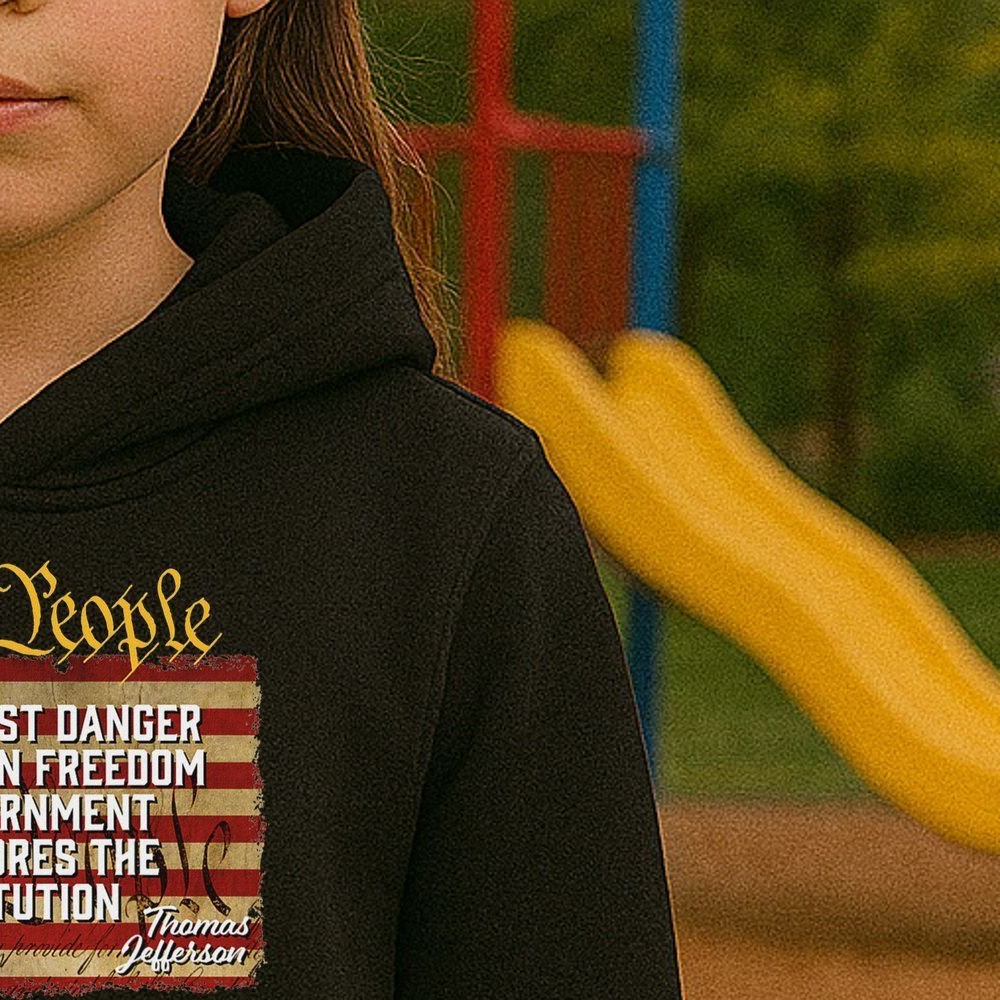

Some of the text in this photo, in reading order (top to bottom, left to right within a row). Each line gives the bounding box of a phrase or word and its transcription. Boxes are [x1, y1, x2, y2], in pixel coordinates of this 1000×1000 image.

[57, 704, 202, 743] DANGER
[35, 749, 206, 787] FREEDOM
[90, 838, 161, 877] THE
[143, 905, 251, 939] Thomas
[115, 934, 247, 975] Jefferson
